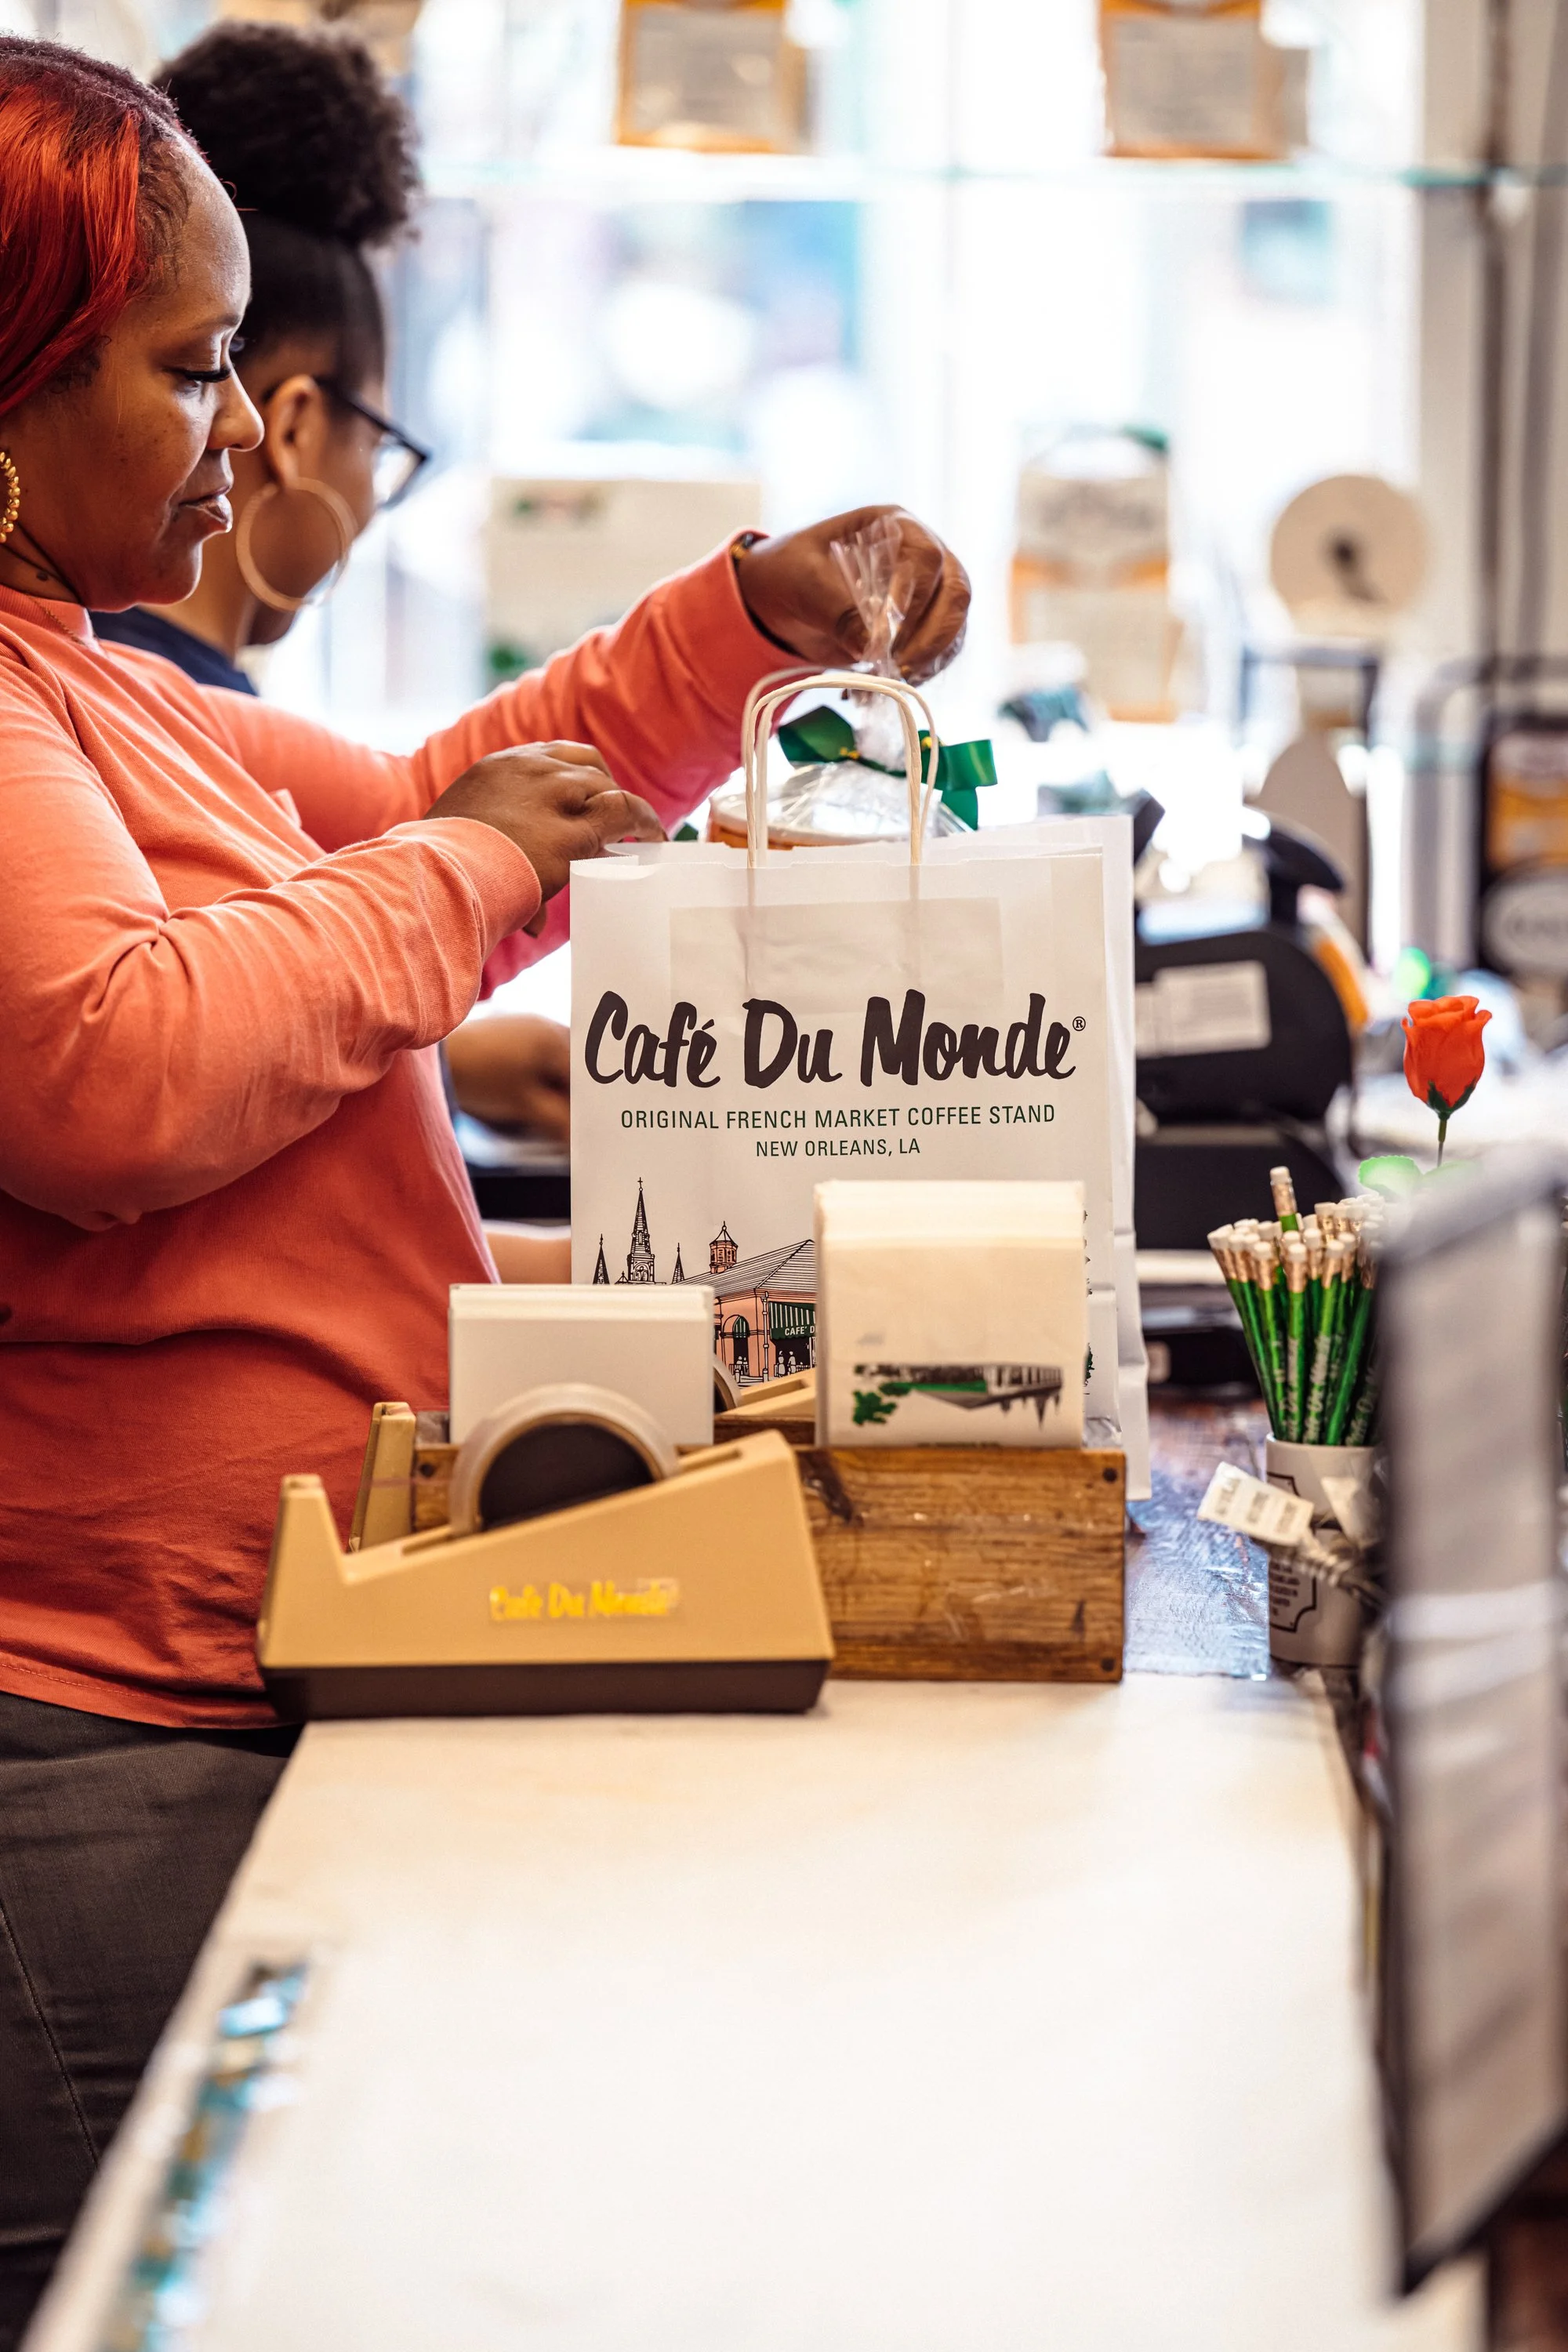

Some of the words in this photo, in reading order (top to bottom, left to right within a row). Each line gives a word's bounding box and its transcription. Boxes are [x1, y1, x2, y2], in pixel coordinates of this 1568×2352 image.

[584, 990, 721, 1088] Café
[742, 997, 843, 1089] Du
[621, 1109, 719, 1129] ORIGINAL
[726, 1110, 806, 1129] FRENCH
[815, 1108, 900, 1128] MARKET
[908, 1106, 982, 1126] COFFEE
[989, 1104, 1054, 1124] STAND
[757, 1141, 798, 1157] NEW
[805, 1138, 892, 1158] ORLEANS,
[899, 1138, 920, 1154] LA
